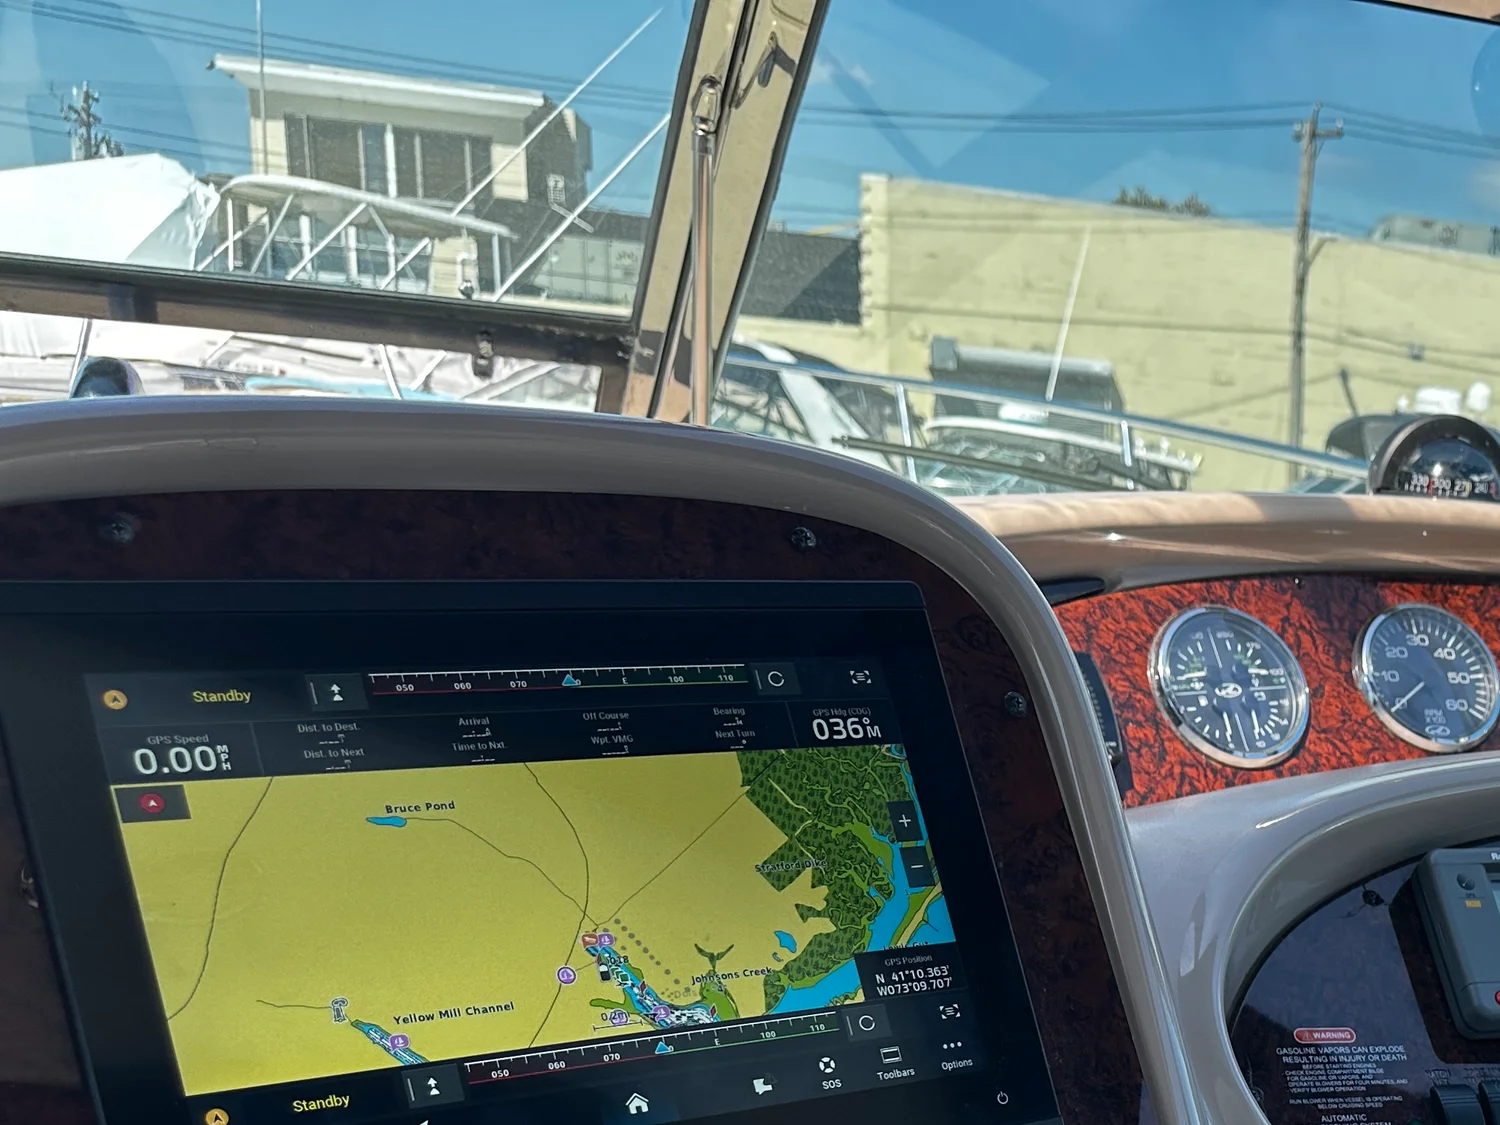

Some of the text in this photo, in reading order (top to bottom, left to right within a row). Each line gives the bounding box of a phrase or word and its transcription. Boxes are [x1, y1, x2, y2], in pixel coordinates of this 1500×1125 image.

[1411, 473, 1429, 486] 330
[1406, 634, 1429, 646] 30
[1385, 647, 1408, 658] 20
[1434, 648, 1456, 660] 40
[1381, 671, 1399, 682] 10
[1448, 672, 1470, 684] 50
[396, 674, 734, 692] 050 060 070 100 110
[192, 690, 251, 703] Standby
[599, 712, 629, 720] Course
[713, 707, 745, 716] Bearing
[458, 717, 490, 726] Arrival
[322, 724, 332, 732] to
[715, 729, 755, 738] Next Turn
[147, 734, 209, 745] GPS Speed
[340, 748, 364, 756] Next
[453, 742, 476, 751] Time
[134, 746, 217, 775] 0.00
[385, 801, 455, 814] Bruce Pond
[885, 954, 932, 966] GPS Position
[691, 966, 772, 984] Johnsons Creek
[876, 973, 885, 984] N
[393, 1001, 515, 1025] Yellow Mill Channel
[491, 1023, 825, 1078] 050 060 070 100 110
[1276, 1047, 1316, 1055] GASOLINE
[1370, 1045, 1405, 1053] EXPLODE
[941, 1058, 973, 1071] Options
[822, 1067, 915, 1090] SOS Toolbars
[292, 1095, 350, 1112] Standby
[1321, 1114, 1367, 1122] AUTOMATIC
